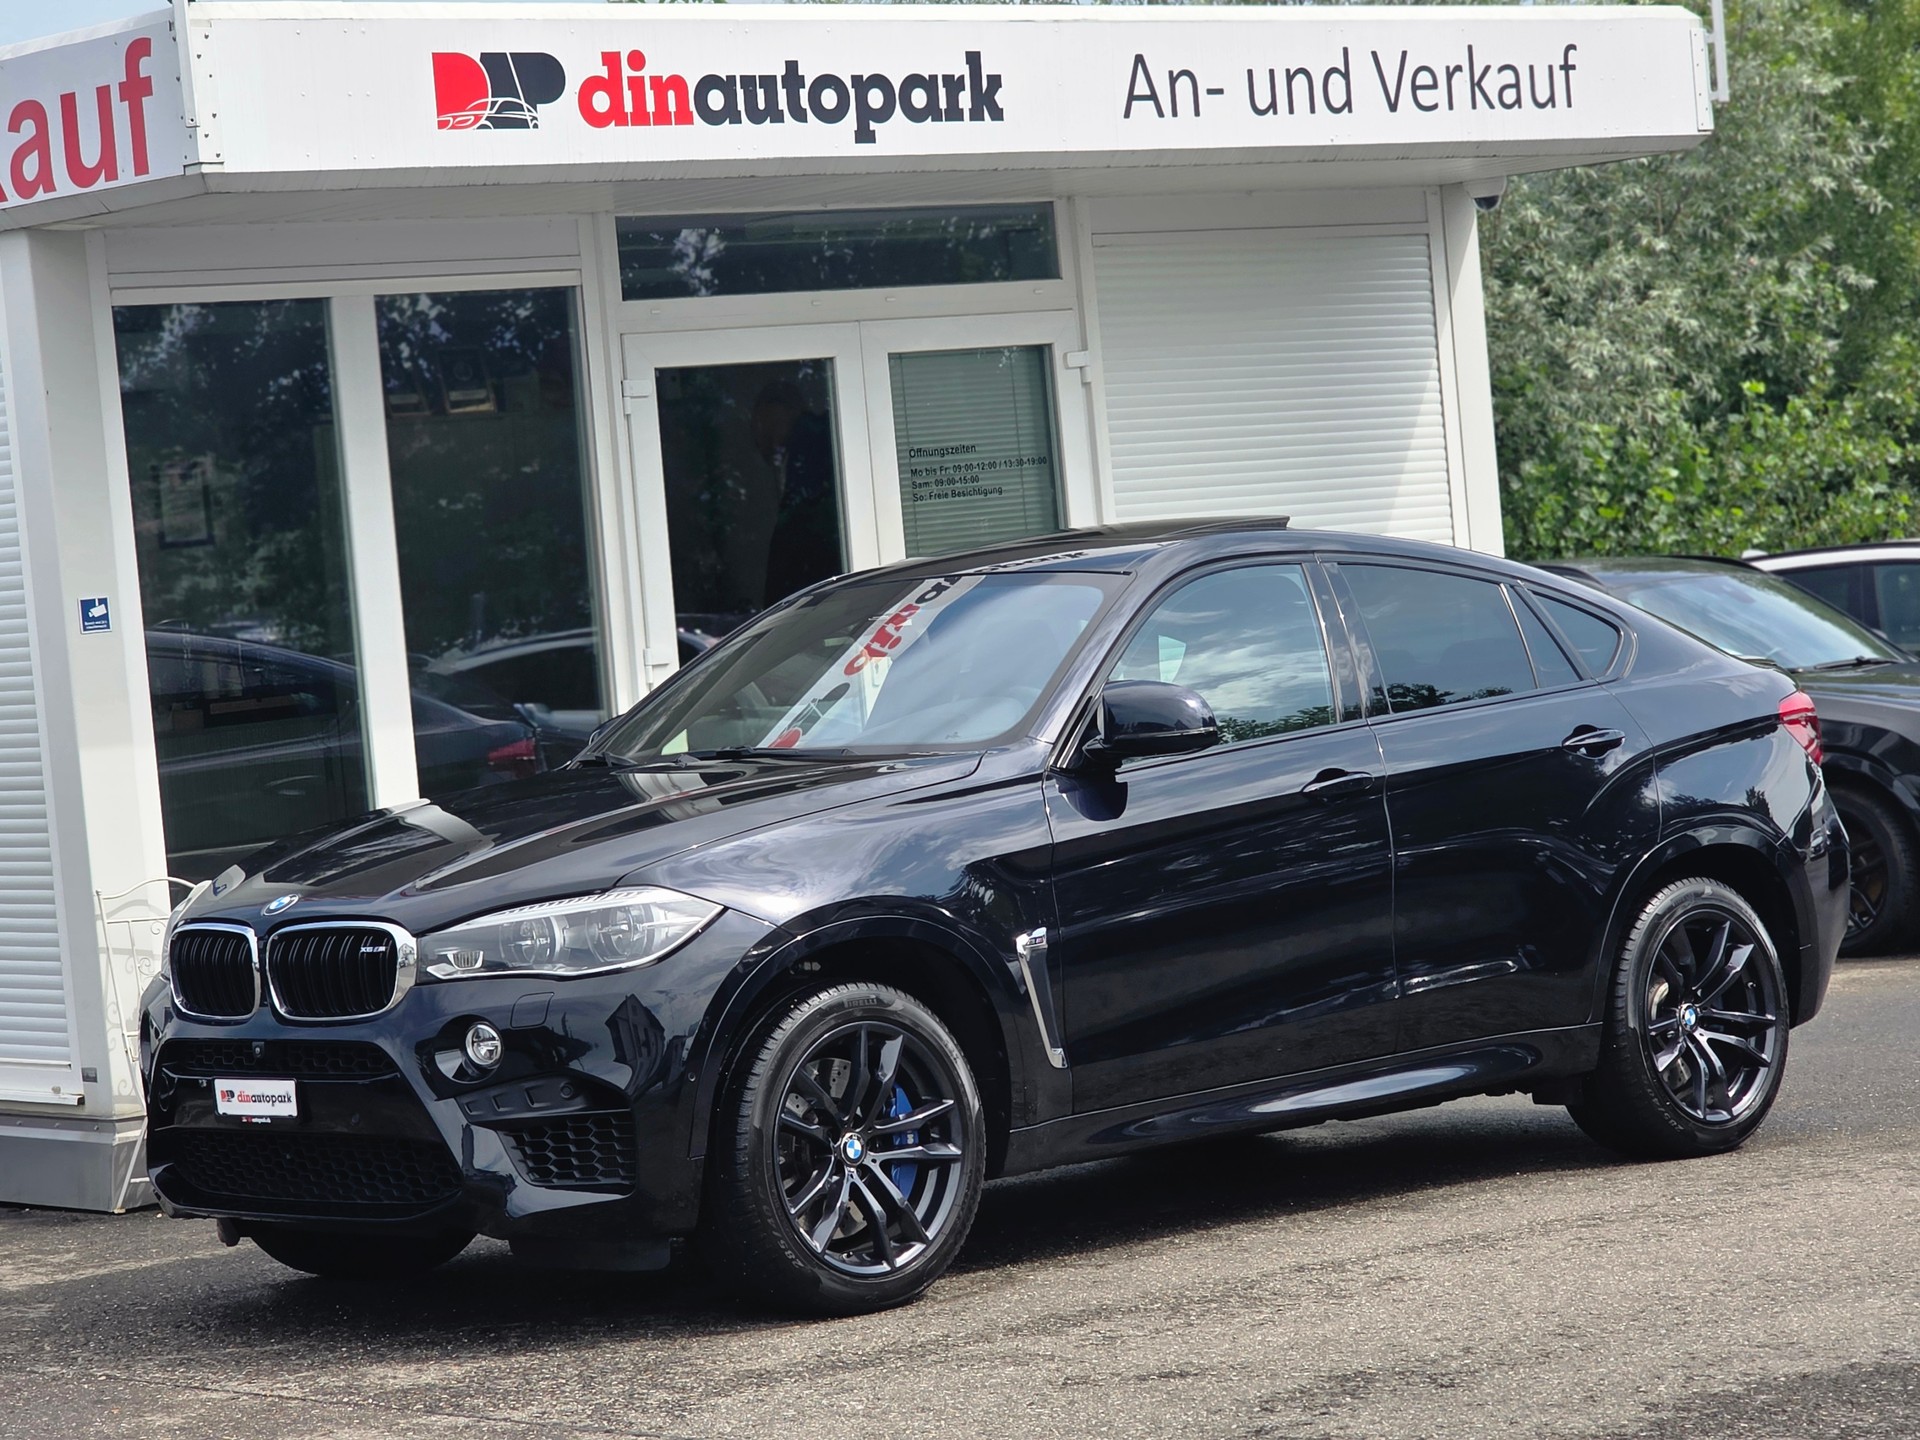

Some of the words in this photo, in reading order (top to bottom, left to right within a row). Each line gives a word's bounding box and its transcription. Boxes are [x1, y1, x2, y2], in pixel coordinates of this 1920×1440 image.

[1123, 53, 1225, 119] An-
[1246, 47, 1353, 116] und
[1371, 44, 1577, 113] Verkauf
[578, 49, 1003, 144] dinautopark
[0, 37, 153, 202] auf
[908, 443, 976, 458] Öffnungszeiten
[910, 468, 923, 477] Mo
[925, 466, 937, 476] bis
[952, 461, 997, 473] 09:00-12:00
[1004, 456, 1048, 468] 13:30-19:00
[911, 480, 932, 490] Sam:
[934, 474, 979, 488] 09:00-15:00
[912, 493, 928, 502] So:
[929, 491, 949, 501] Freie
[951, 486, 1003, 498] Besichtigung
[237, 1091, 292, 1107] dinautopark
